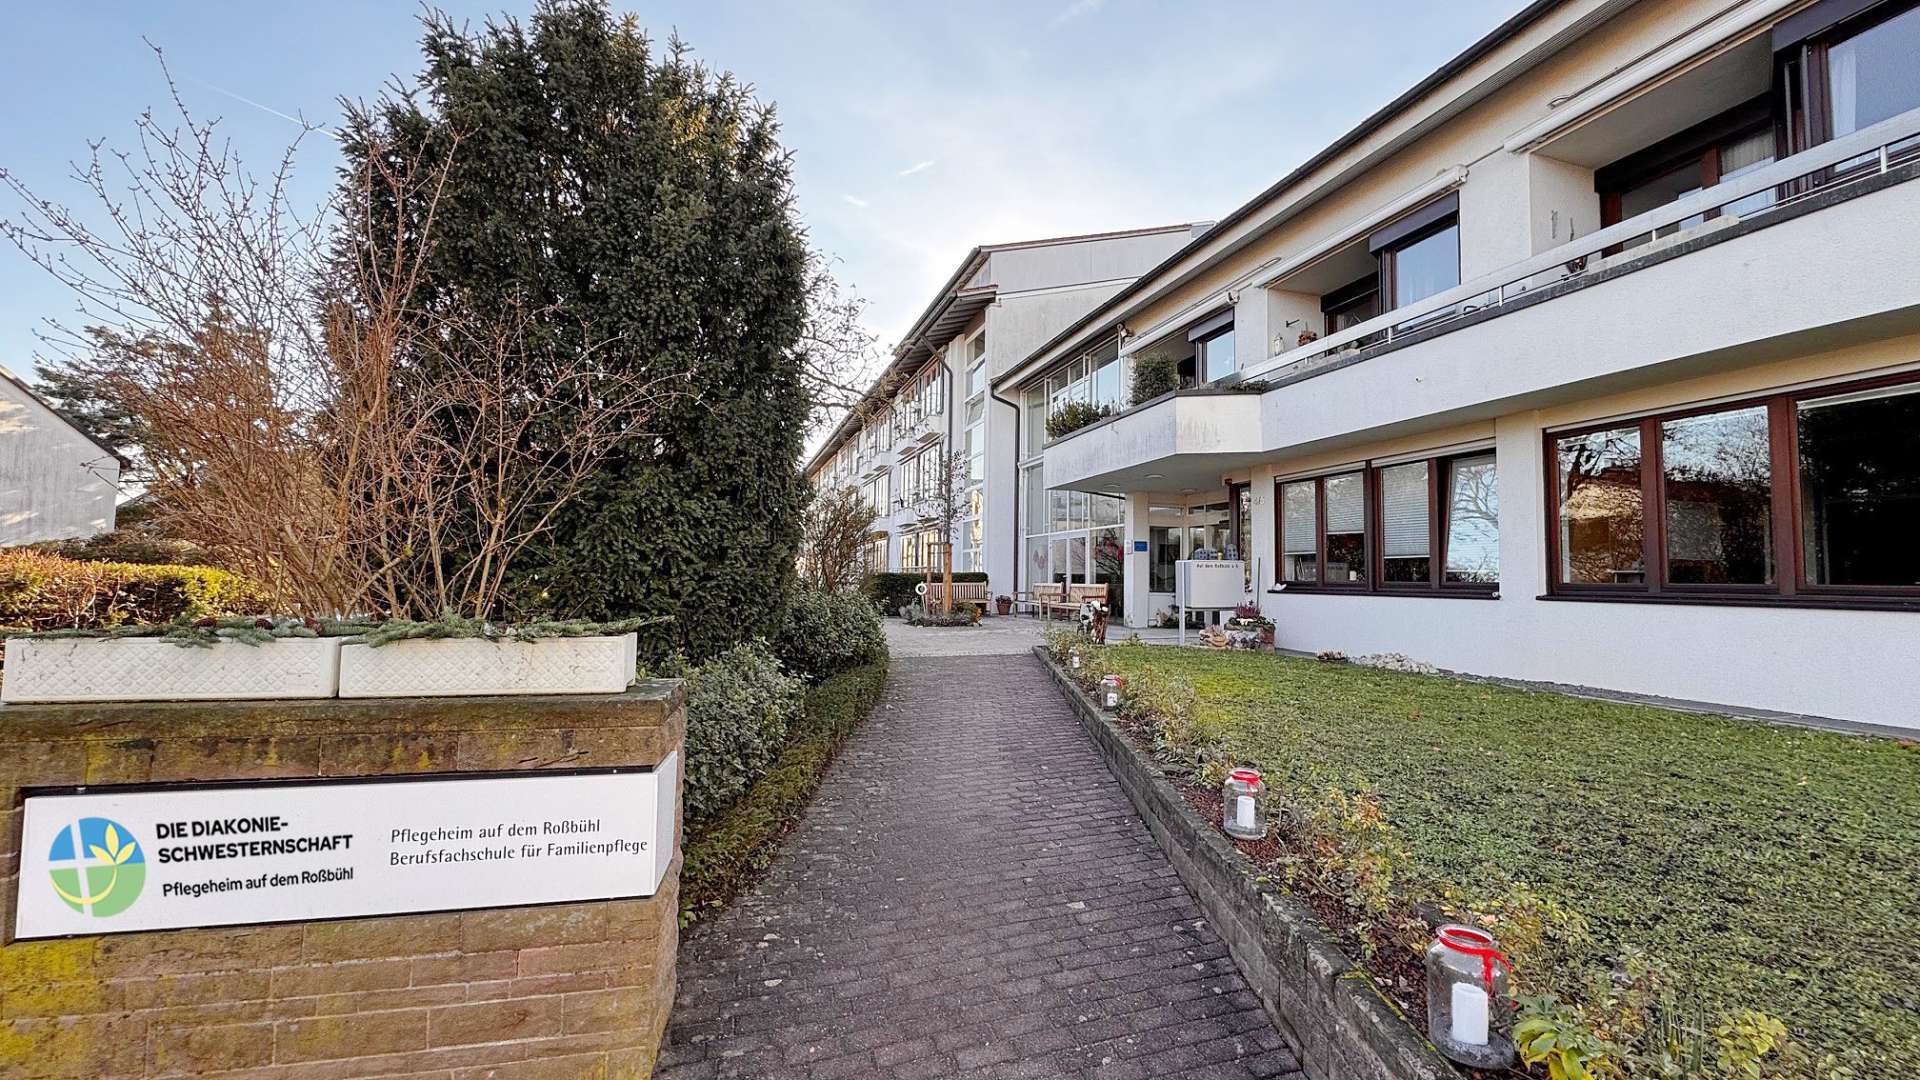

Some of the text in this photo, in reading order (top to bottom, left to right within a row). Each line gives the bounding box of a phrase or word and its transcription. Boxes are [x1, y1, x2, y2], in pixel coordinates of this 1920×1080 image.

[156, 816, 288, 839] DIE DIAKONIE-
[392, 819, 599, 845] Pflegeheim auf dem Roßbühl
[158, 834, 353, 863] SCHWESTERNSCHAFT
[391, 840, 647, 865] Berufsfachschule für Familienpflege
[163, 867, 353, 897] Pflegeheim auf dem Roßbühl
